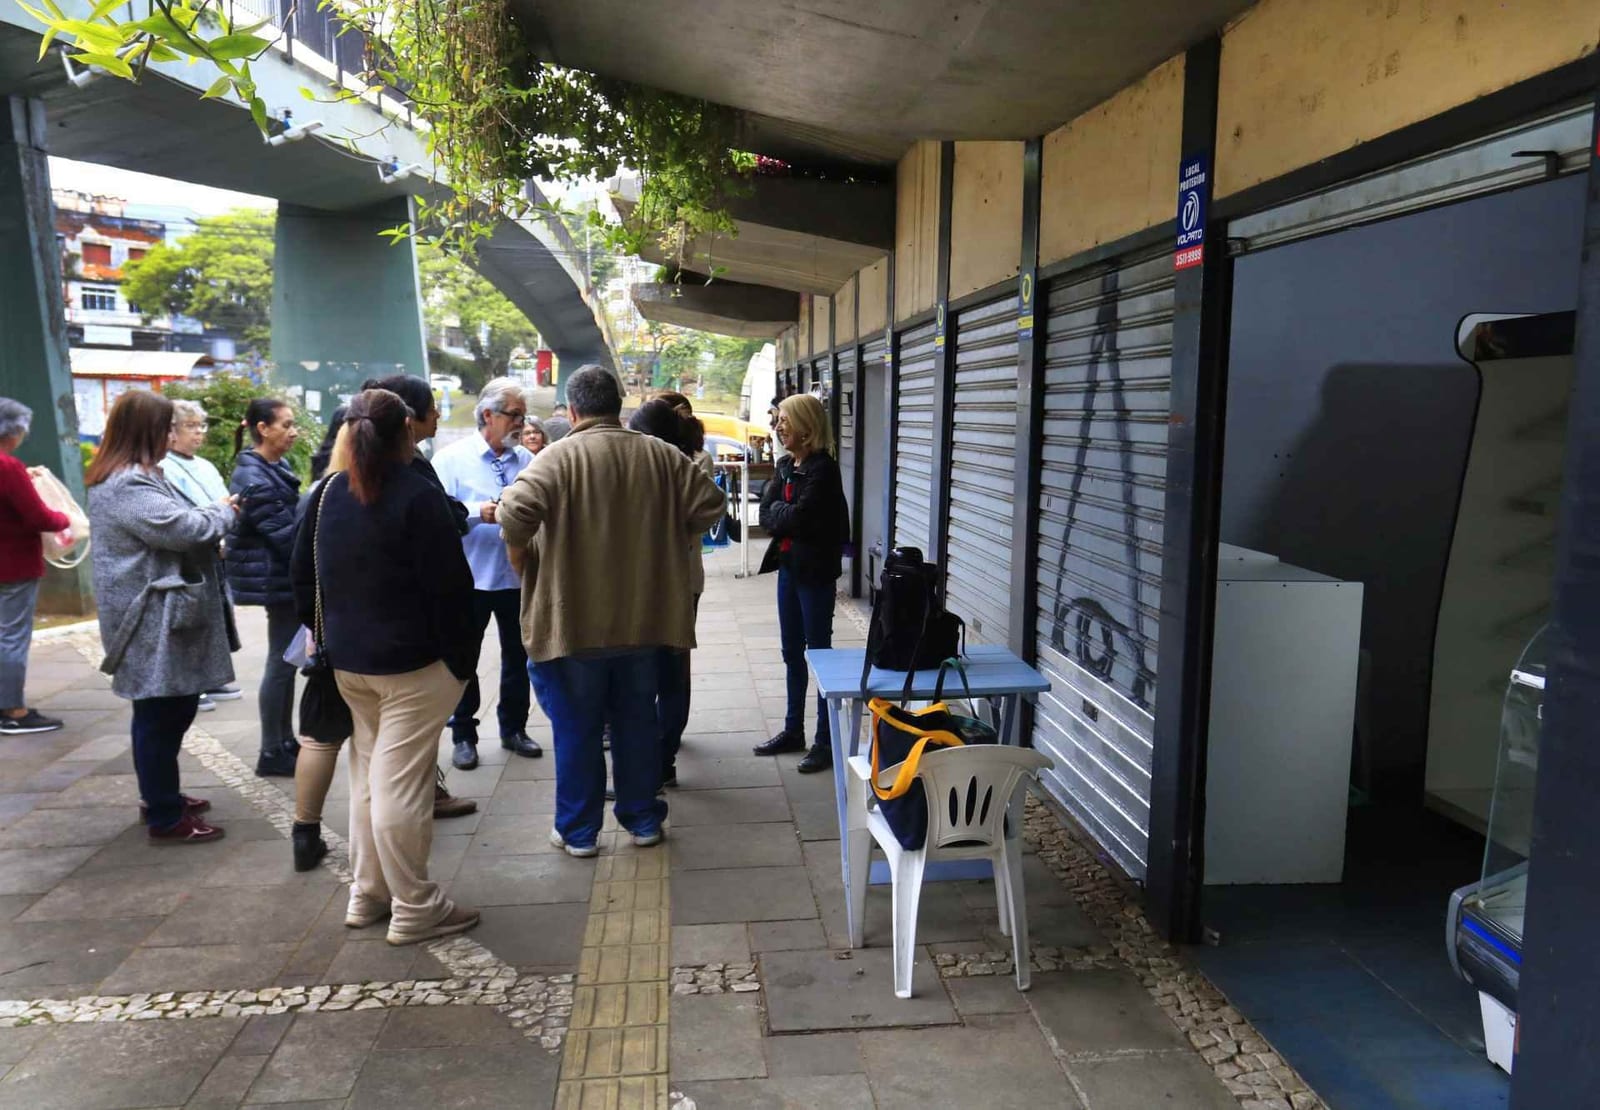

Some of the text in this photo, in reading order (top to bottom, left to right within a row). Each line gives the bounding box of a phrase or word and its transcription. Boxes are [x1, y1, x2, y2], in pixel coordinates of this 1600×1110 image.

[1185, 162, 1200, 178] LOCAL
[1180, 172, 1205, 192] PROTEGIDO
[1177, 229, 1203, 245] VOLPATO
